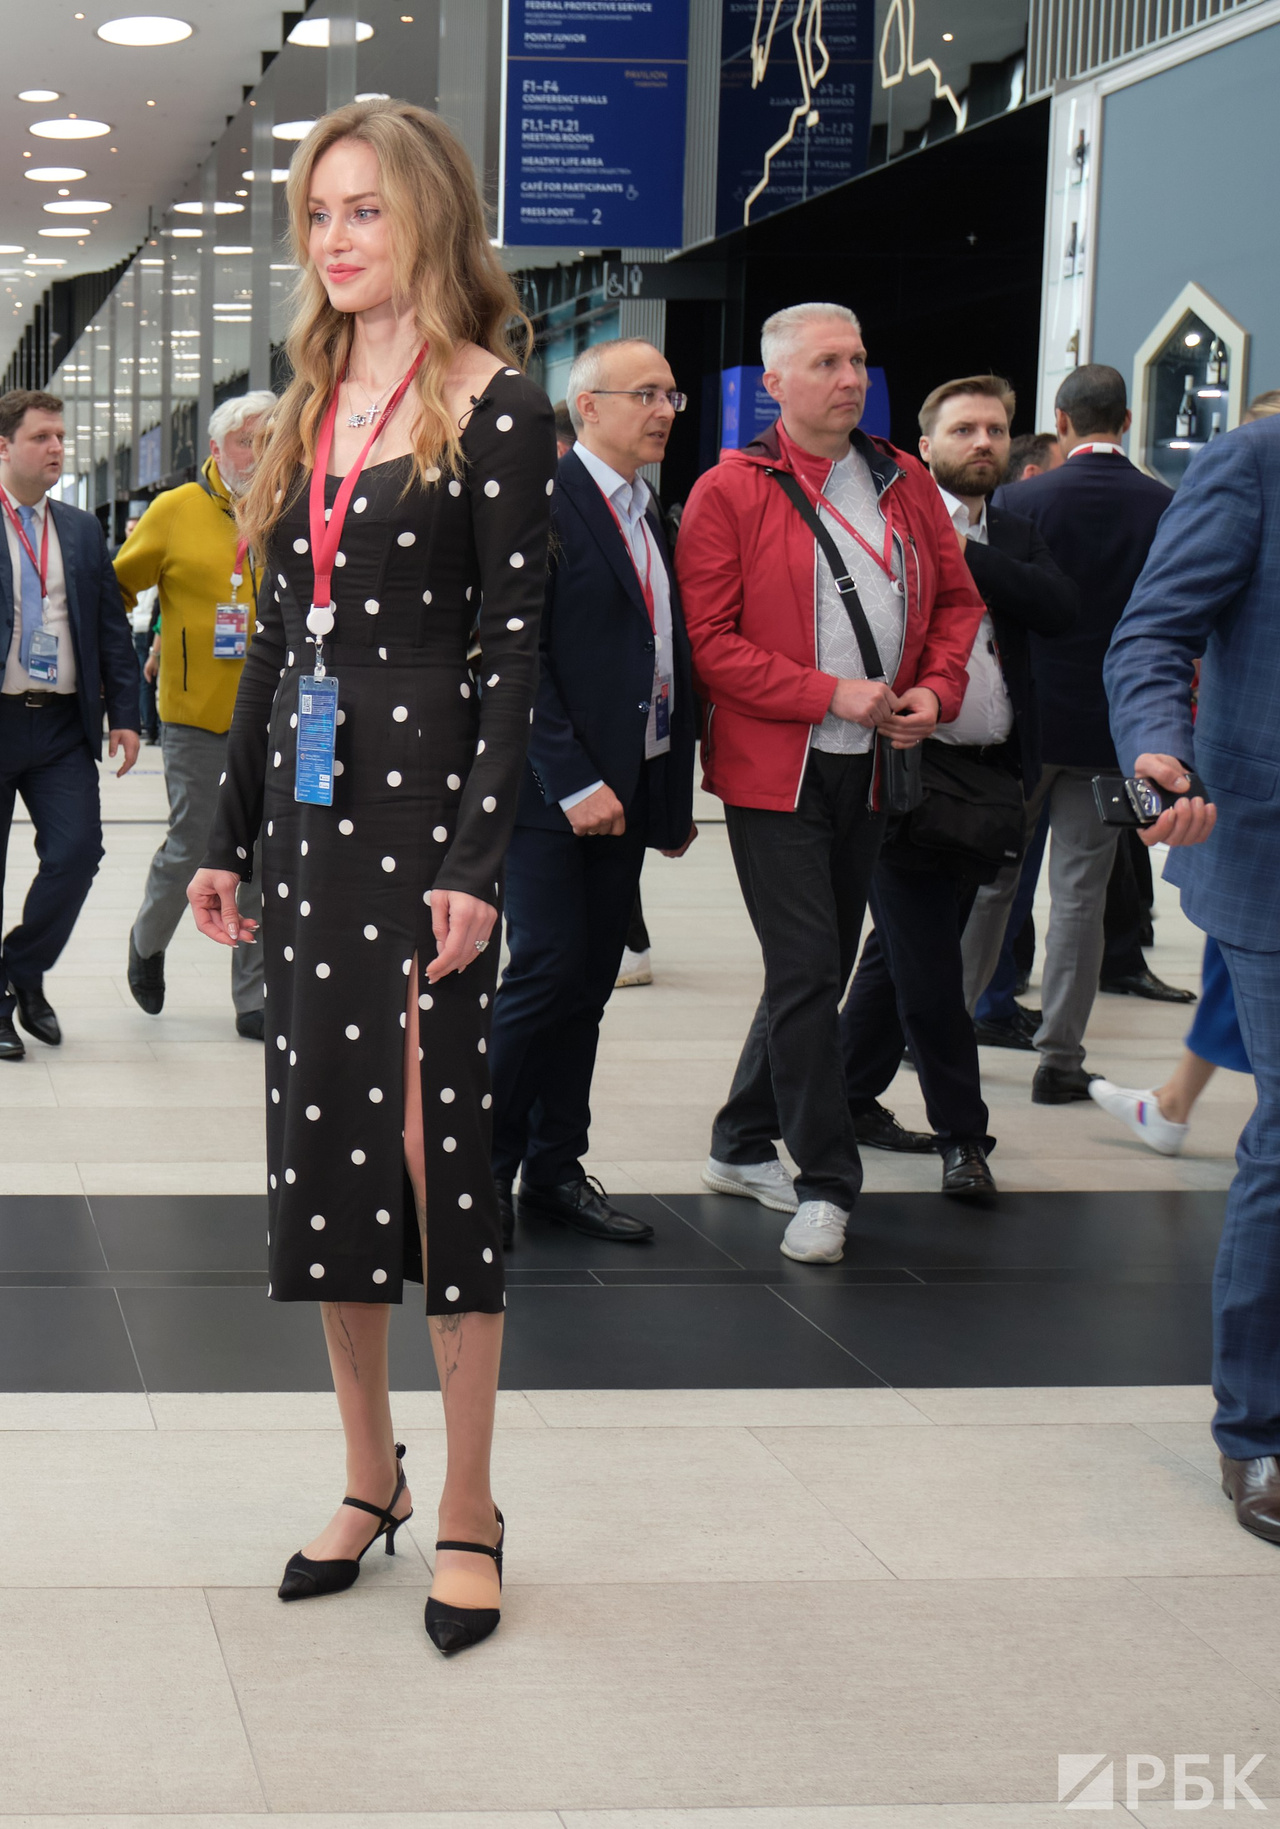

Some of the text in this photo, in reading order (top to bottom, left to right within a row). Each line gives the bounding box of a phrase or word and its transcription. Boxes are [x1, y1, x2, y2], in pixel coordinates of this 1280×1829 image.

[525, 1, 652, 12] FEDERAL PROTECTIVE SERVICE
[524, 33, 586, 43] POINT JUNIOR
[522, 94, 608, 105] CONFERENCE HALLS
[522, 133, 595, 143] MEETING ROOMS
[522, 156, 604, 167] HEALTHY LIFE AREA
[521, 180, 623, 193] CAFÉ FOR PARTICIPANTS
[521, 207, 546, 217] PRESS
[547, 208, 575, 217] POINT
[592, 208, 602, 225] 2
